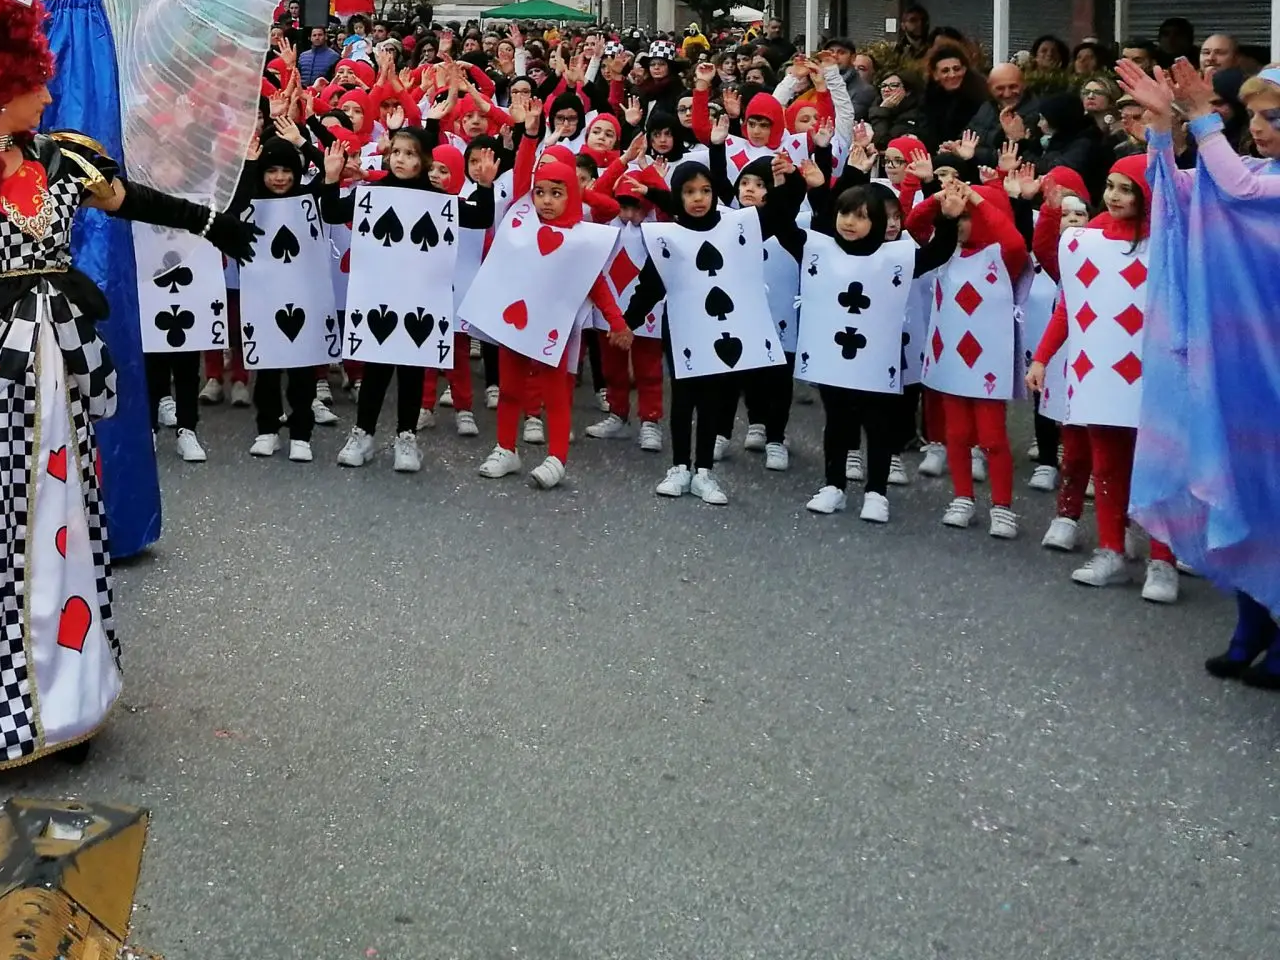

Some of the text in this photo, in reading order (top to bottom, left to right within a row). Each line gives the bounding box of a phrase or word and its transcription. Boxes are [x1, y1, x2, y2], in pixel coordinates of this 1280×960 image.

[302, 199, 317, 222] 2
[358, 191, 372, 213] 4
[441, 200, 453, 222] 4
[516, 204, 530, 219] 2
[738, 224, 744, 234] 3
[657, 237, 667, 247] 3
[810, 254, 819, 266] 2
[988, 260, 997, 273] 4
[894, 265, 902, 276] 2
[211, 320, 224, 344] 3
[244, 341, 259, 365] 2
[325, 334, 340, 358] 2
[348, 332, 362, 356] 4
[437, 340, 450, 364] 4
[801, 362, 808, 373] 2
[889, 378, 895, 388] 2
